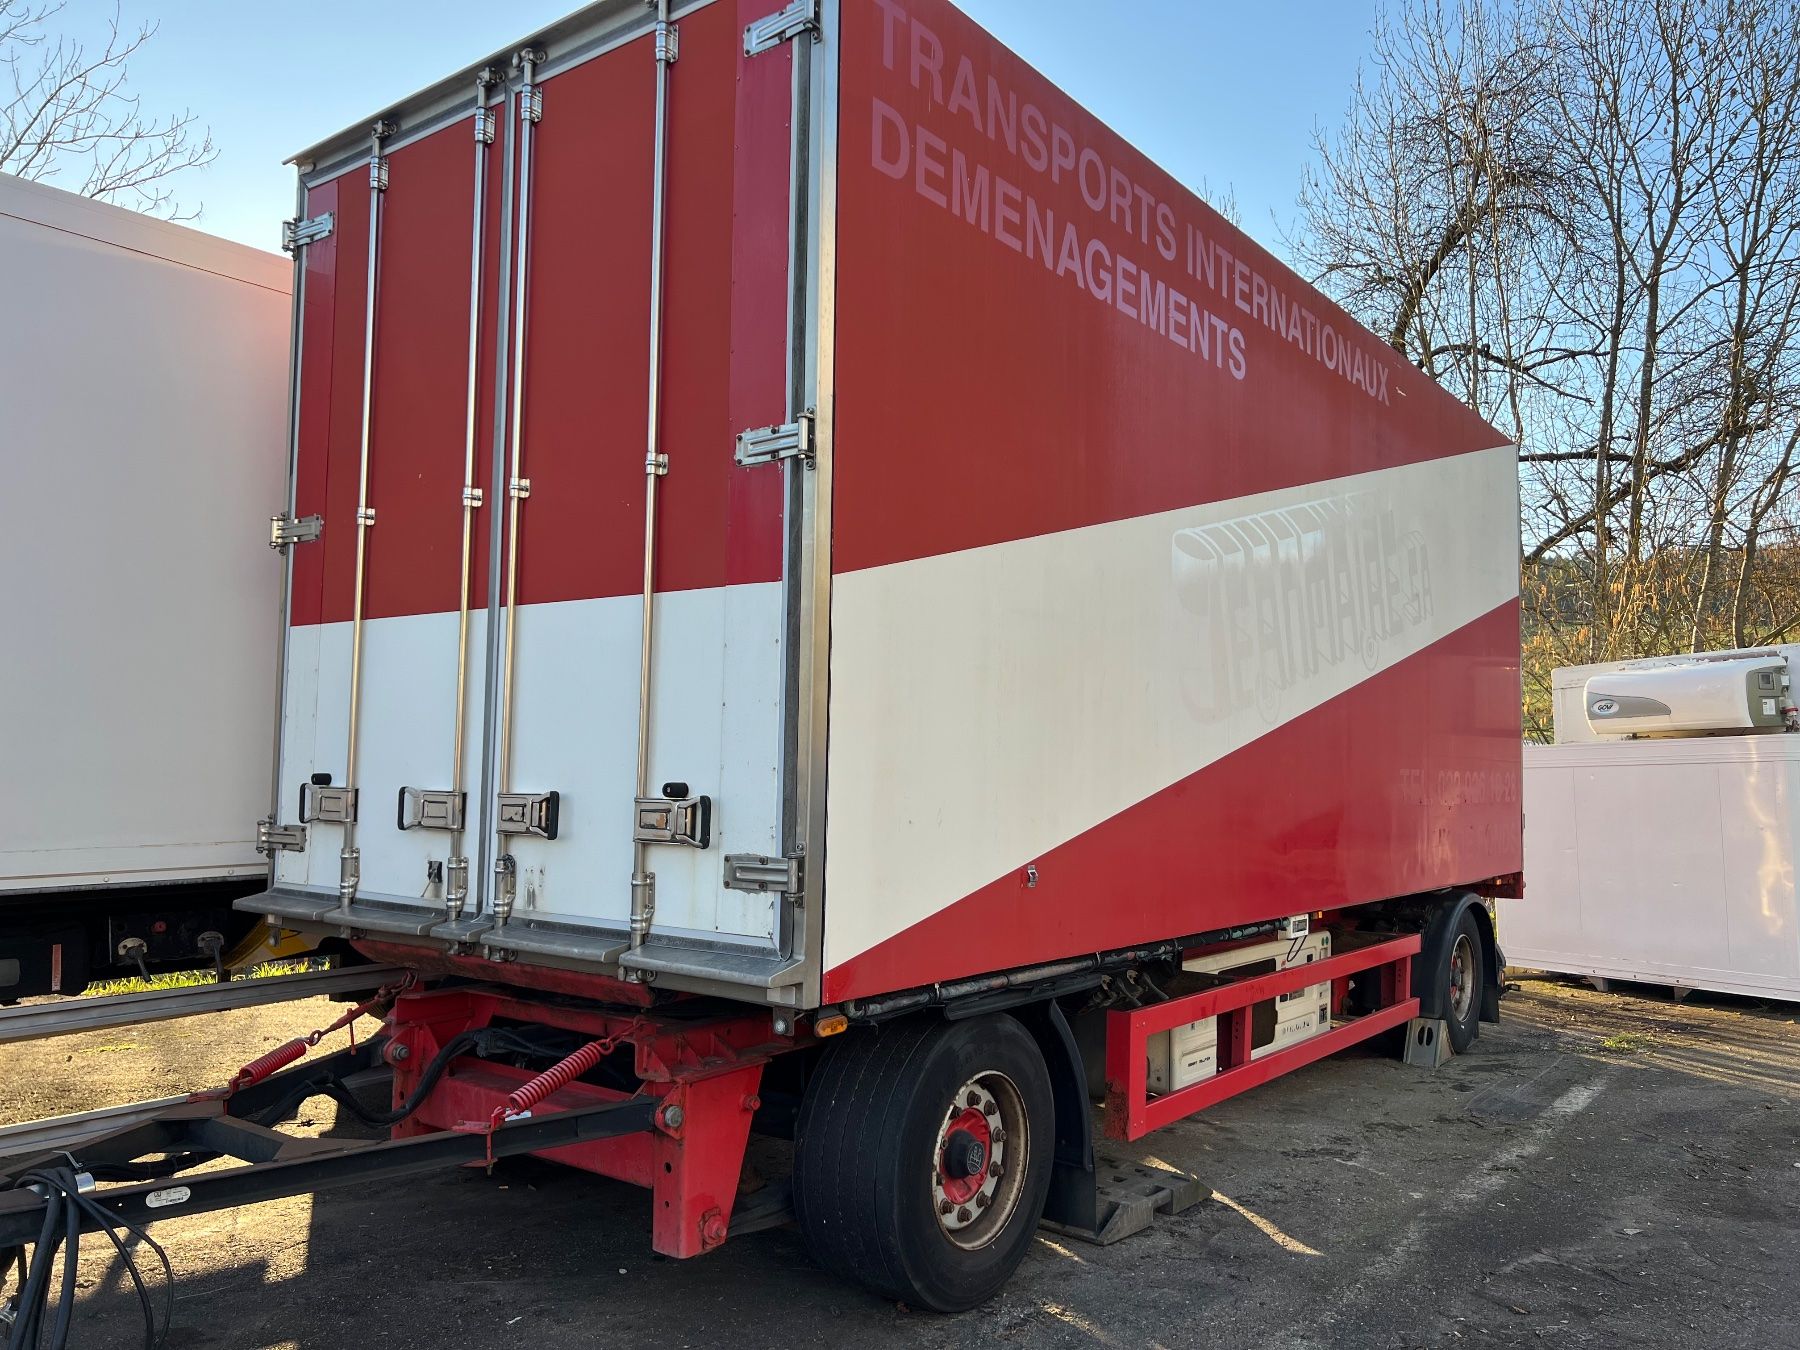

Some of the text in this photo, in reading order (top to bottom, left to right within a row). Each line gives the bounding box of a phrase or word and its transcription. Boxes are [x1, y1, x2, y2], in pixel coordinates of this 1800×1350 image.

[871, 96, 1247, 381] DEMENAGEMENTS
[874, 0, 1390, 406] TRANSPORTS INTERNATIONAUX
